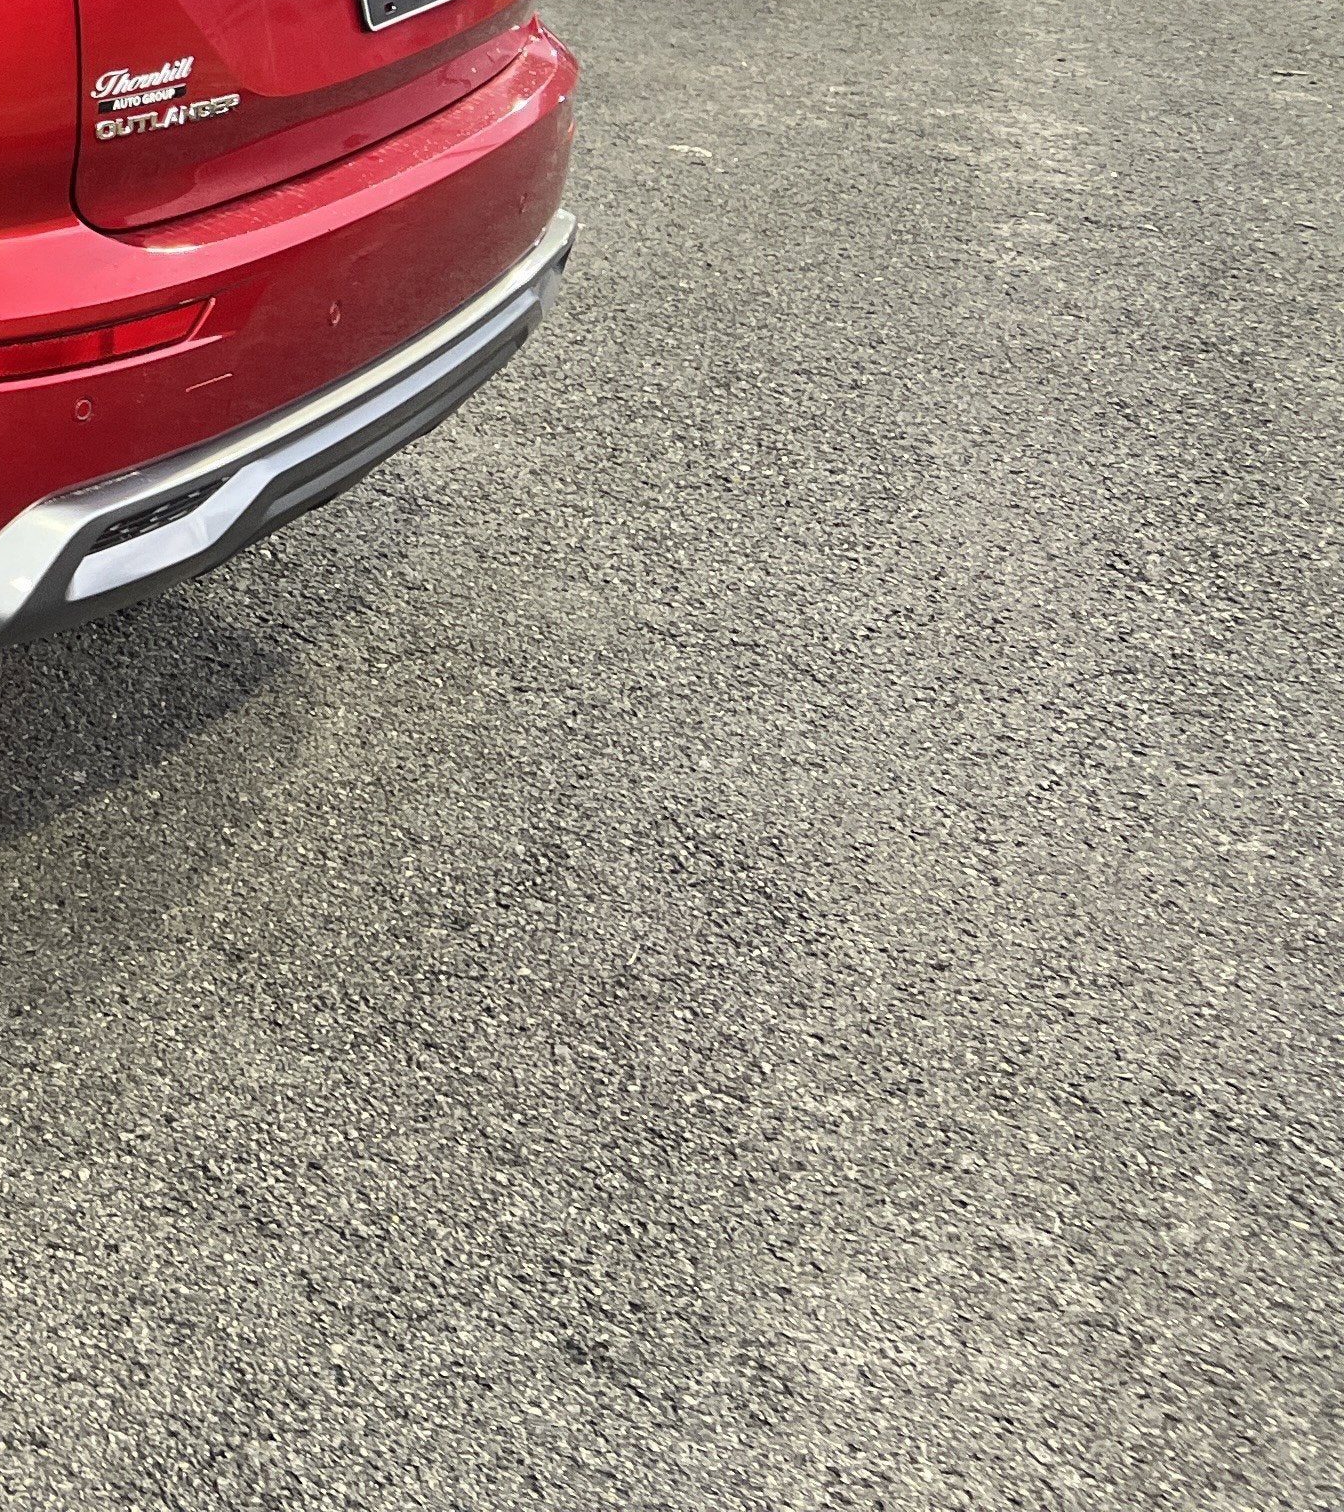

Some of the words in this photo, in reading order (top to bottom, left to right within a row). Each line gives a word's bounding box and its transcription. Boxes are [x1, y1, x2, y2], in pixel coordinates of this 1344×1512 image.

[90, 56, 194, 98] Thornhill
[95, 93, 240, 140] OUTLANDER
[113, 95, 140, 110] AUTO
[142, 88, 176, 105] GROUP
